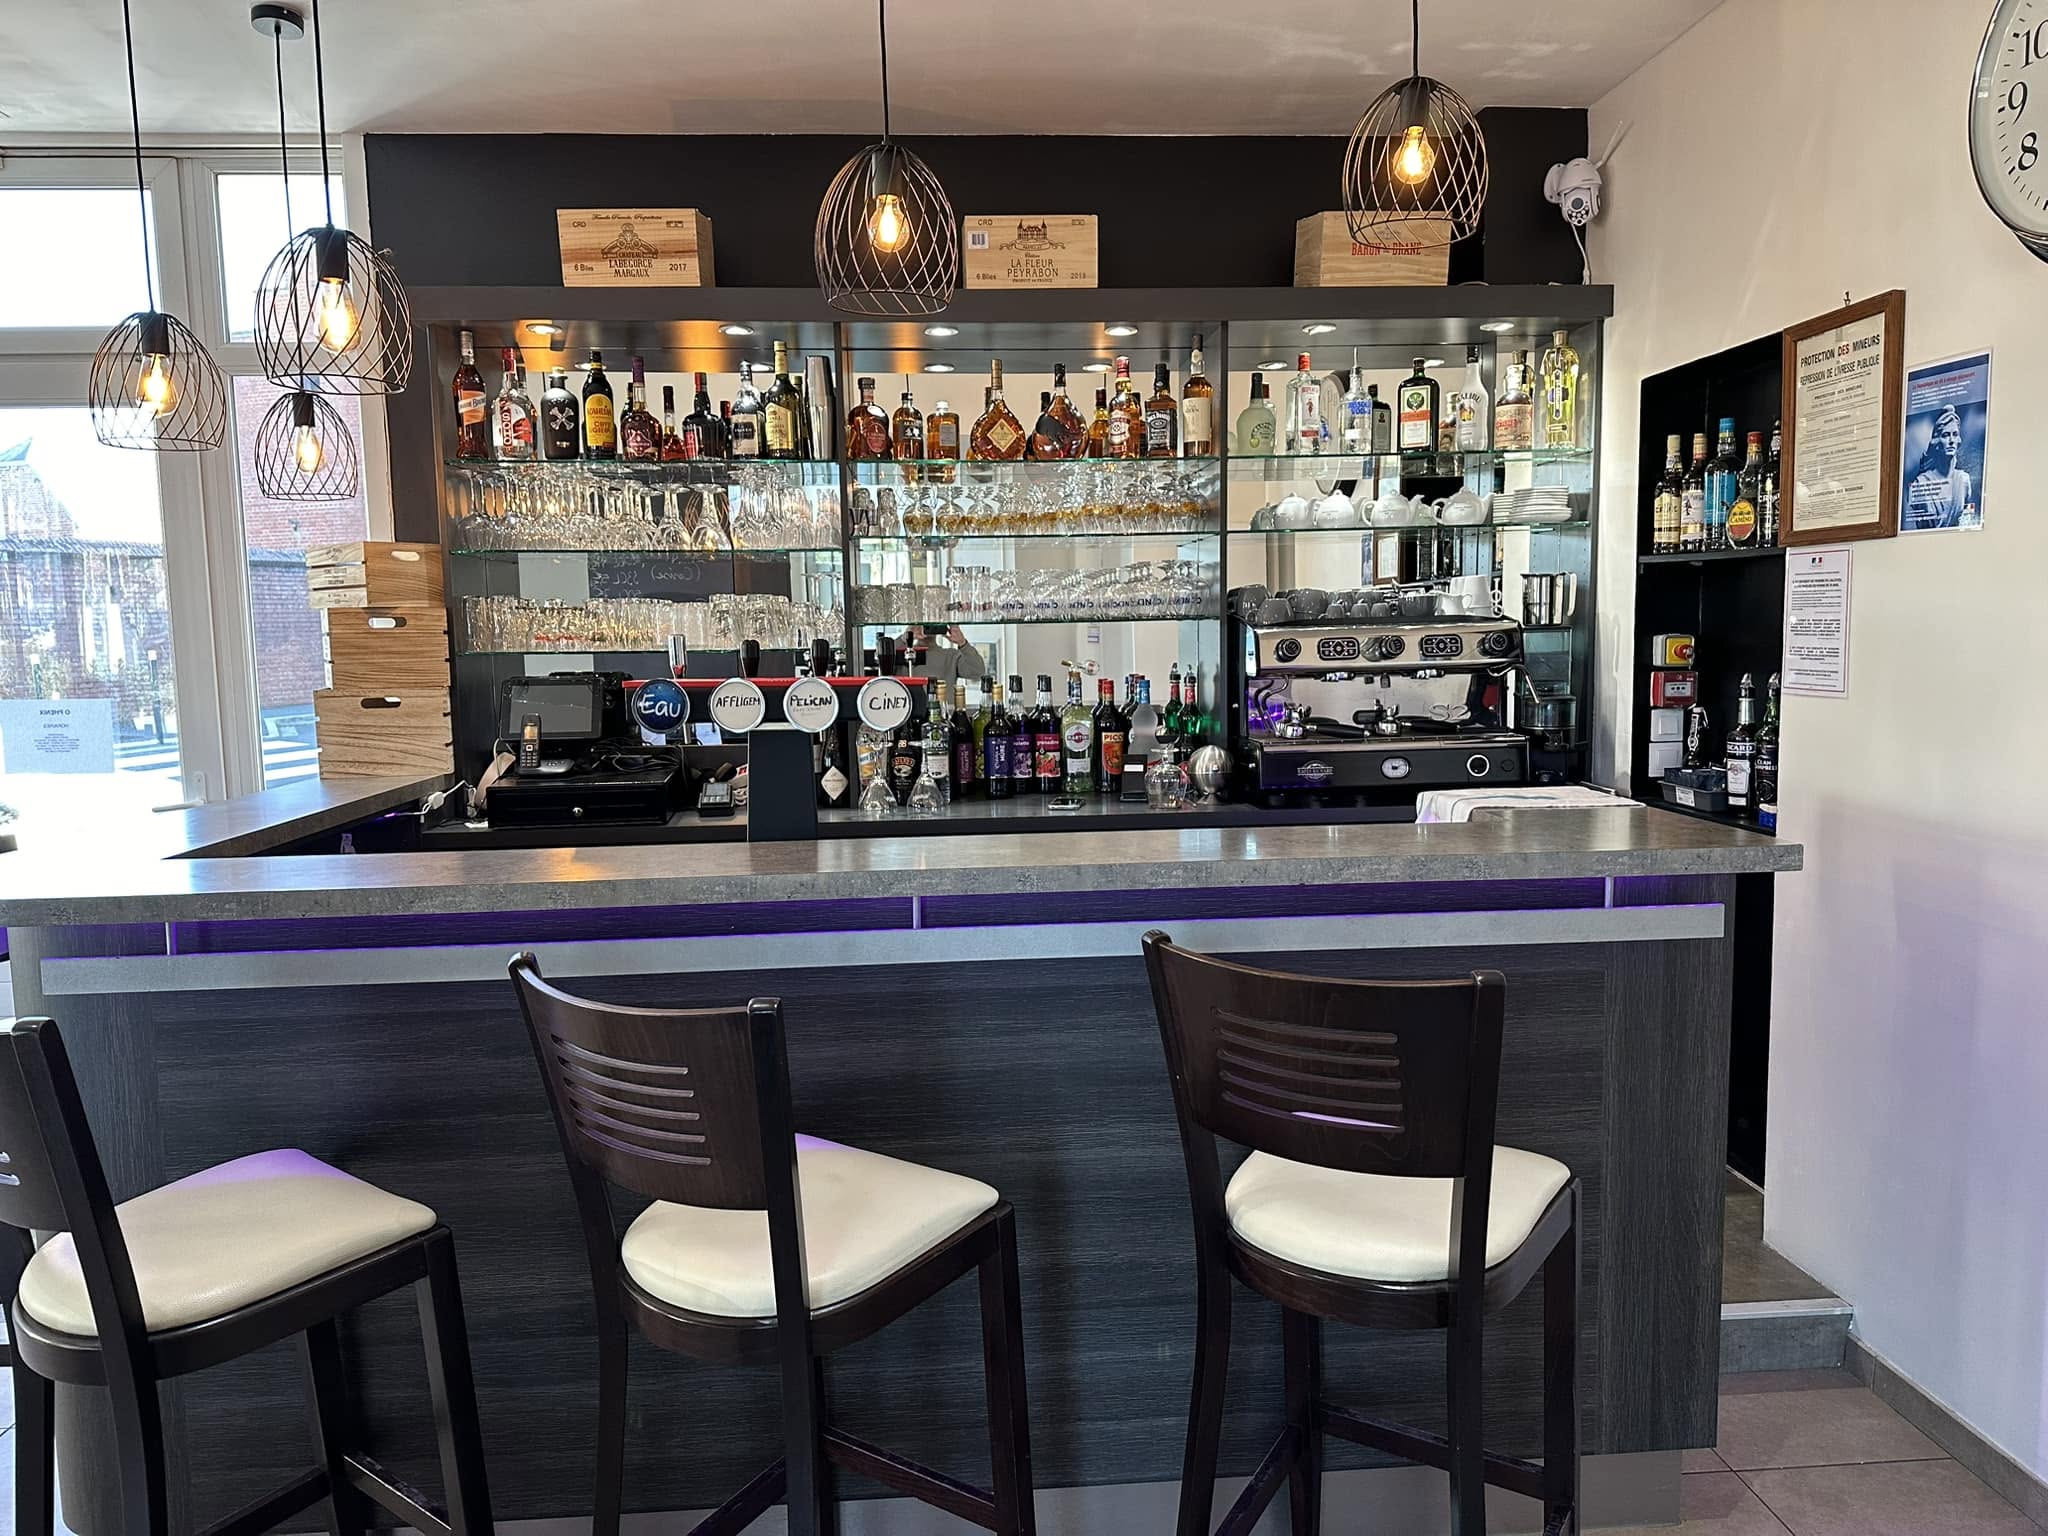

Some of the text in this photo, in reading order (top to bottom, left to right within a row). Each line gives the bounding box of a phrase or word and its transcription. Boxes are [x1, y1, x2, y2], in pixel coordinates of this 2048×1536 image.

[2008, 81, 2028, 126] 9
[2018, 132, 2039, 171] 8
[613, 269, 650, 278] MARGAUX
[1007, 268, 1059, 278] PEYRABON
[1011, 259, 1054, 268] LA FLEUR
[1800, 334, 1880, 368] PROTECTION DES MINEURS
